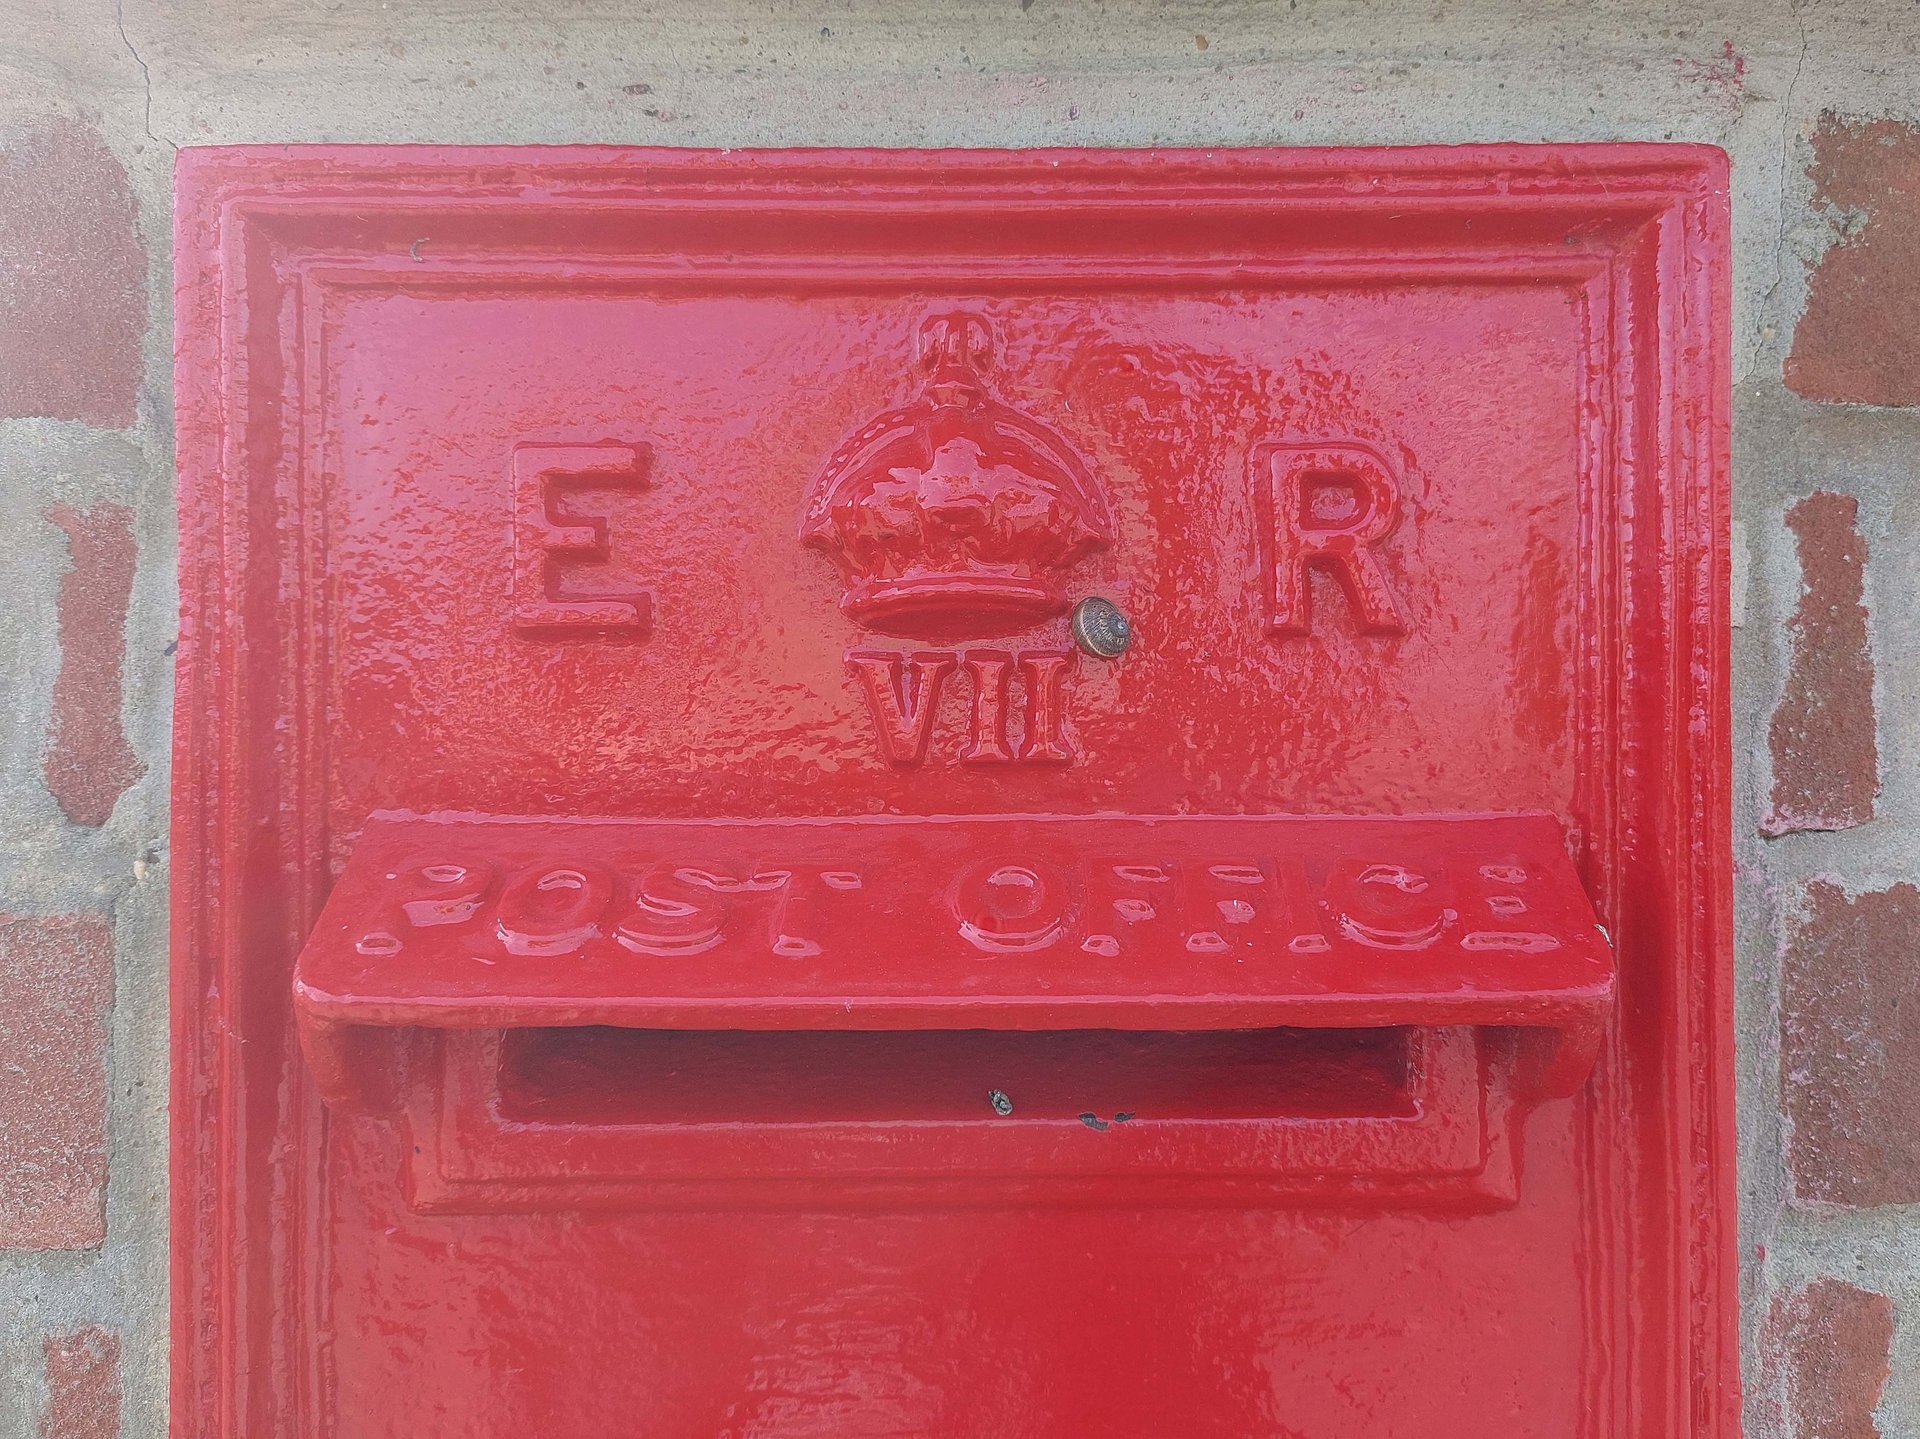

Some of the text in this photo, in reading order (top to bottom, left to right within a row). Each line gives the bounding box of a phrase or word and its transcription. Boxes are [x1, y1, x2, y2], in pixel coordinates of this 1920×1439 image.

[512, 438, 1406, 640] E R
[842, 647, 1082, 766] VII
[354, 860, 1563, 957] POST OFFICE
